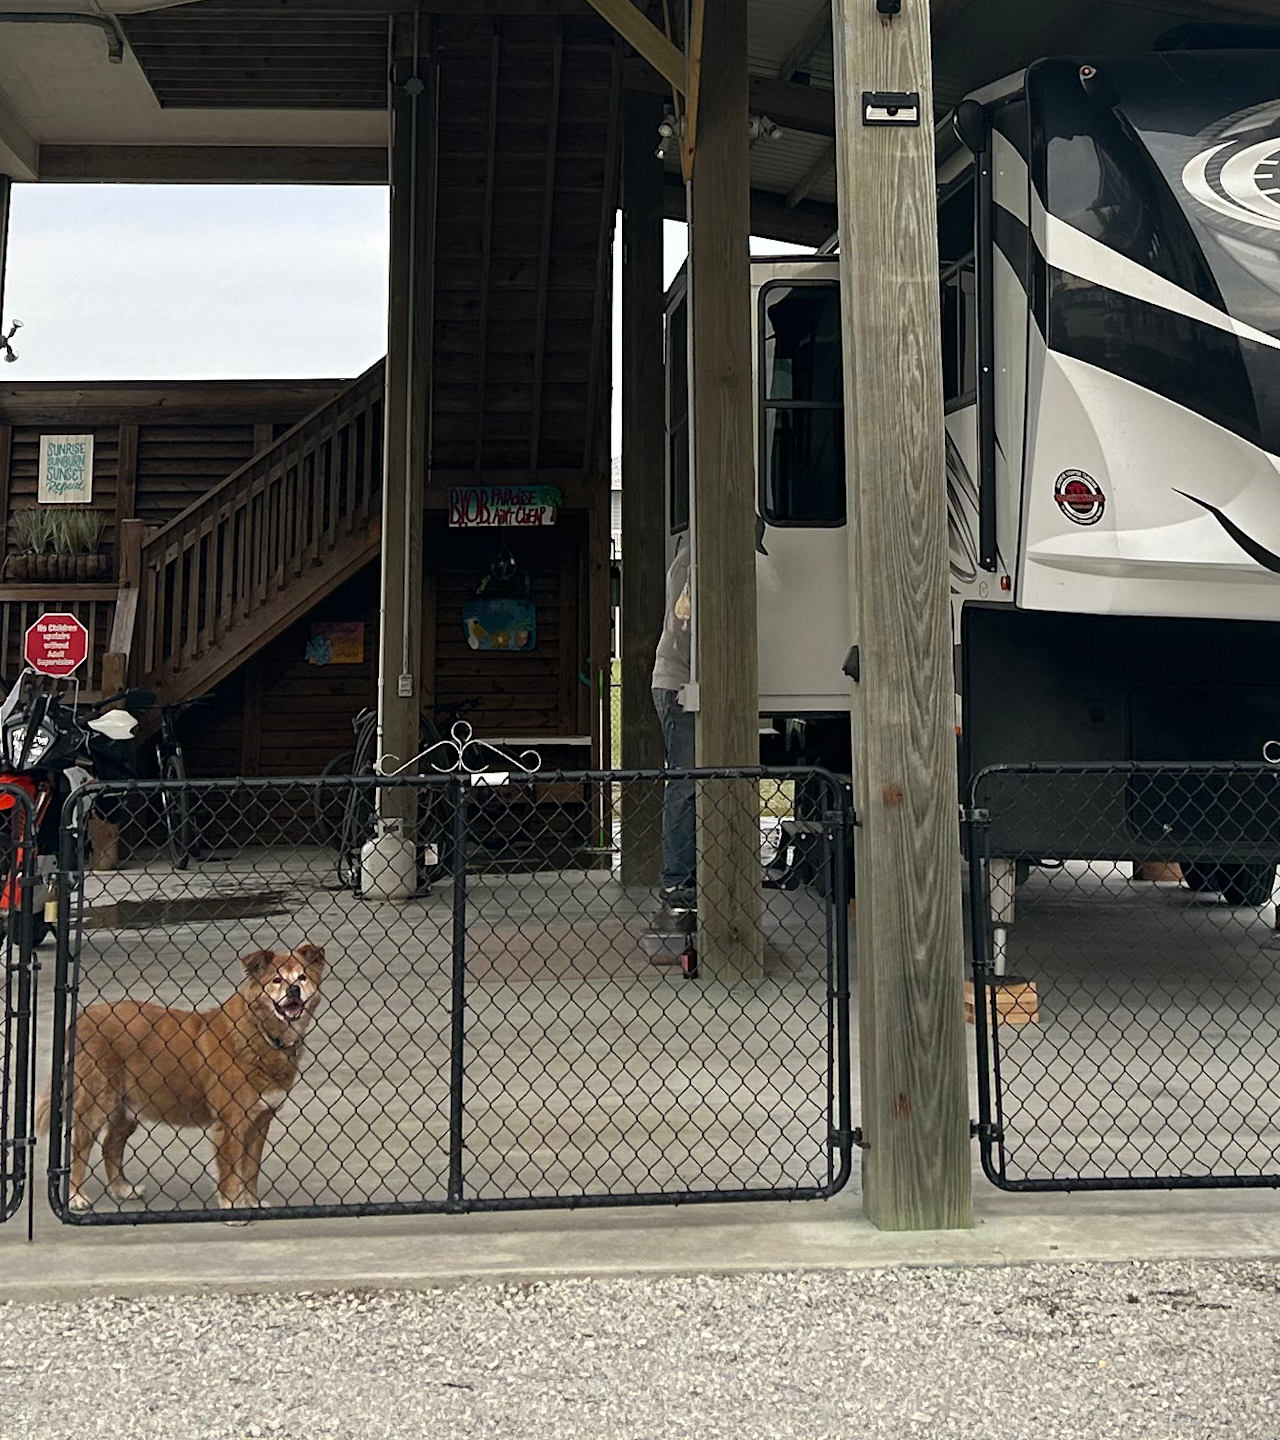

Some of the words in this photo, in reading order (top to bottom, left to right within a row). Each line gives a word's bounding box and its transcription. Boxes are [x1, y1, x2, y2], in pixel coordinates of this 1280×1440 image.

[47, 443, 85, 456] SUNRISE
[47, 466, 85, 481] SUNSET
[37, 624, 47, 632] No
[48, 624, 78, 632] Children
